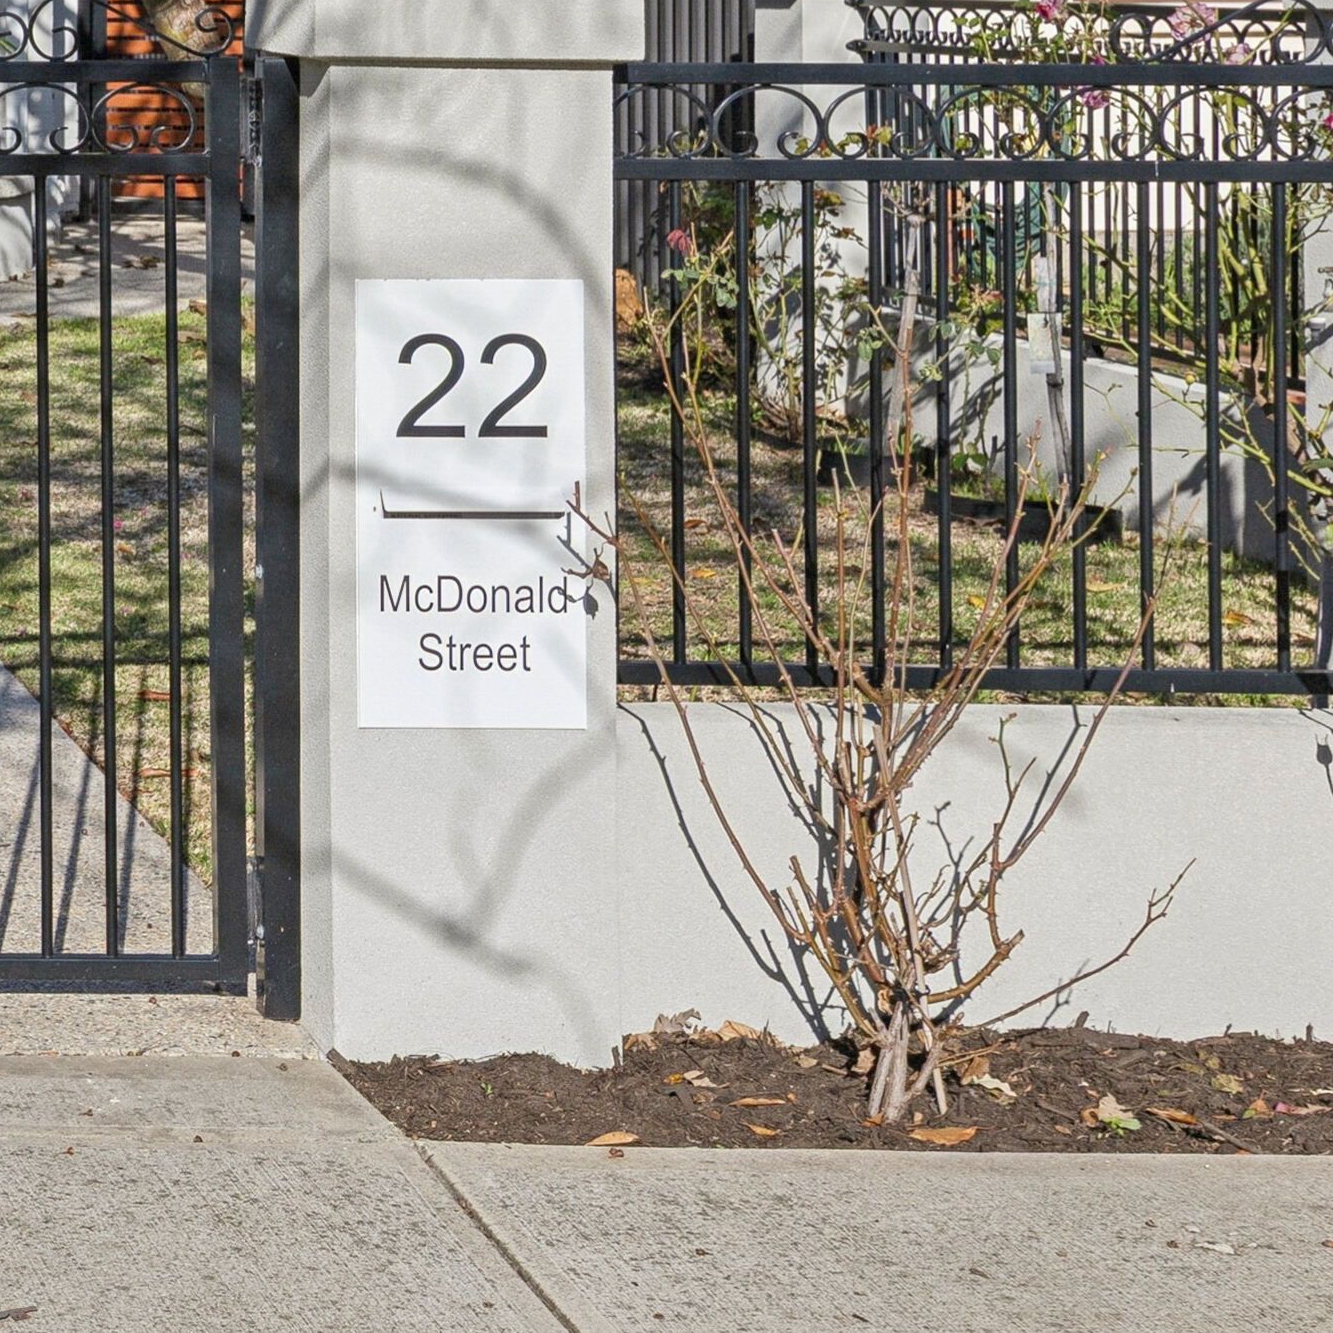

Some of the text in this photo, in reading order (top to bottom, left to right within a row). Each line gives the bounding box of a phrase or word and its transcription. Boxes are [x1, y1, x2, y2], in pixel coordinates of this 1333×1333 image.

[396, 333, 548, 439] 22
[380, 574, 568, 614] McDonald
[418, 632, 531, 672] Street
